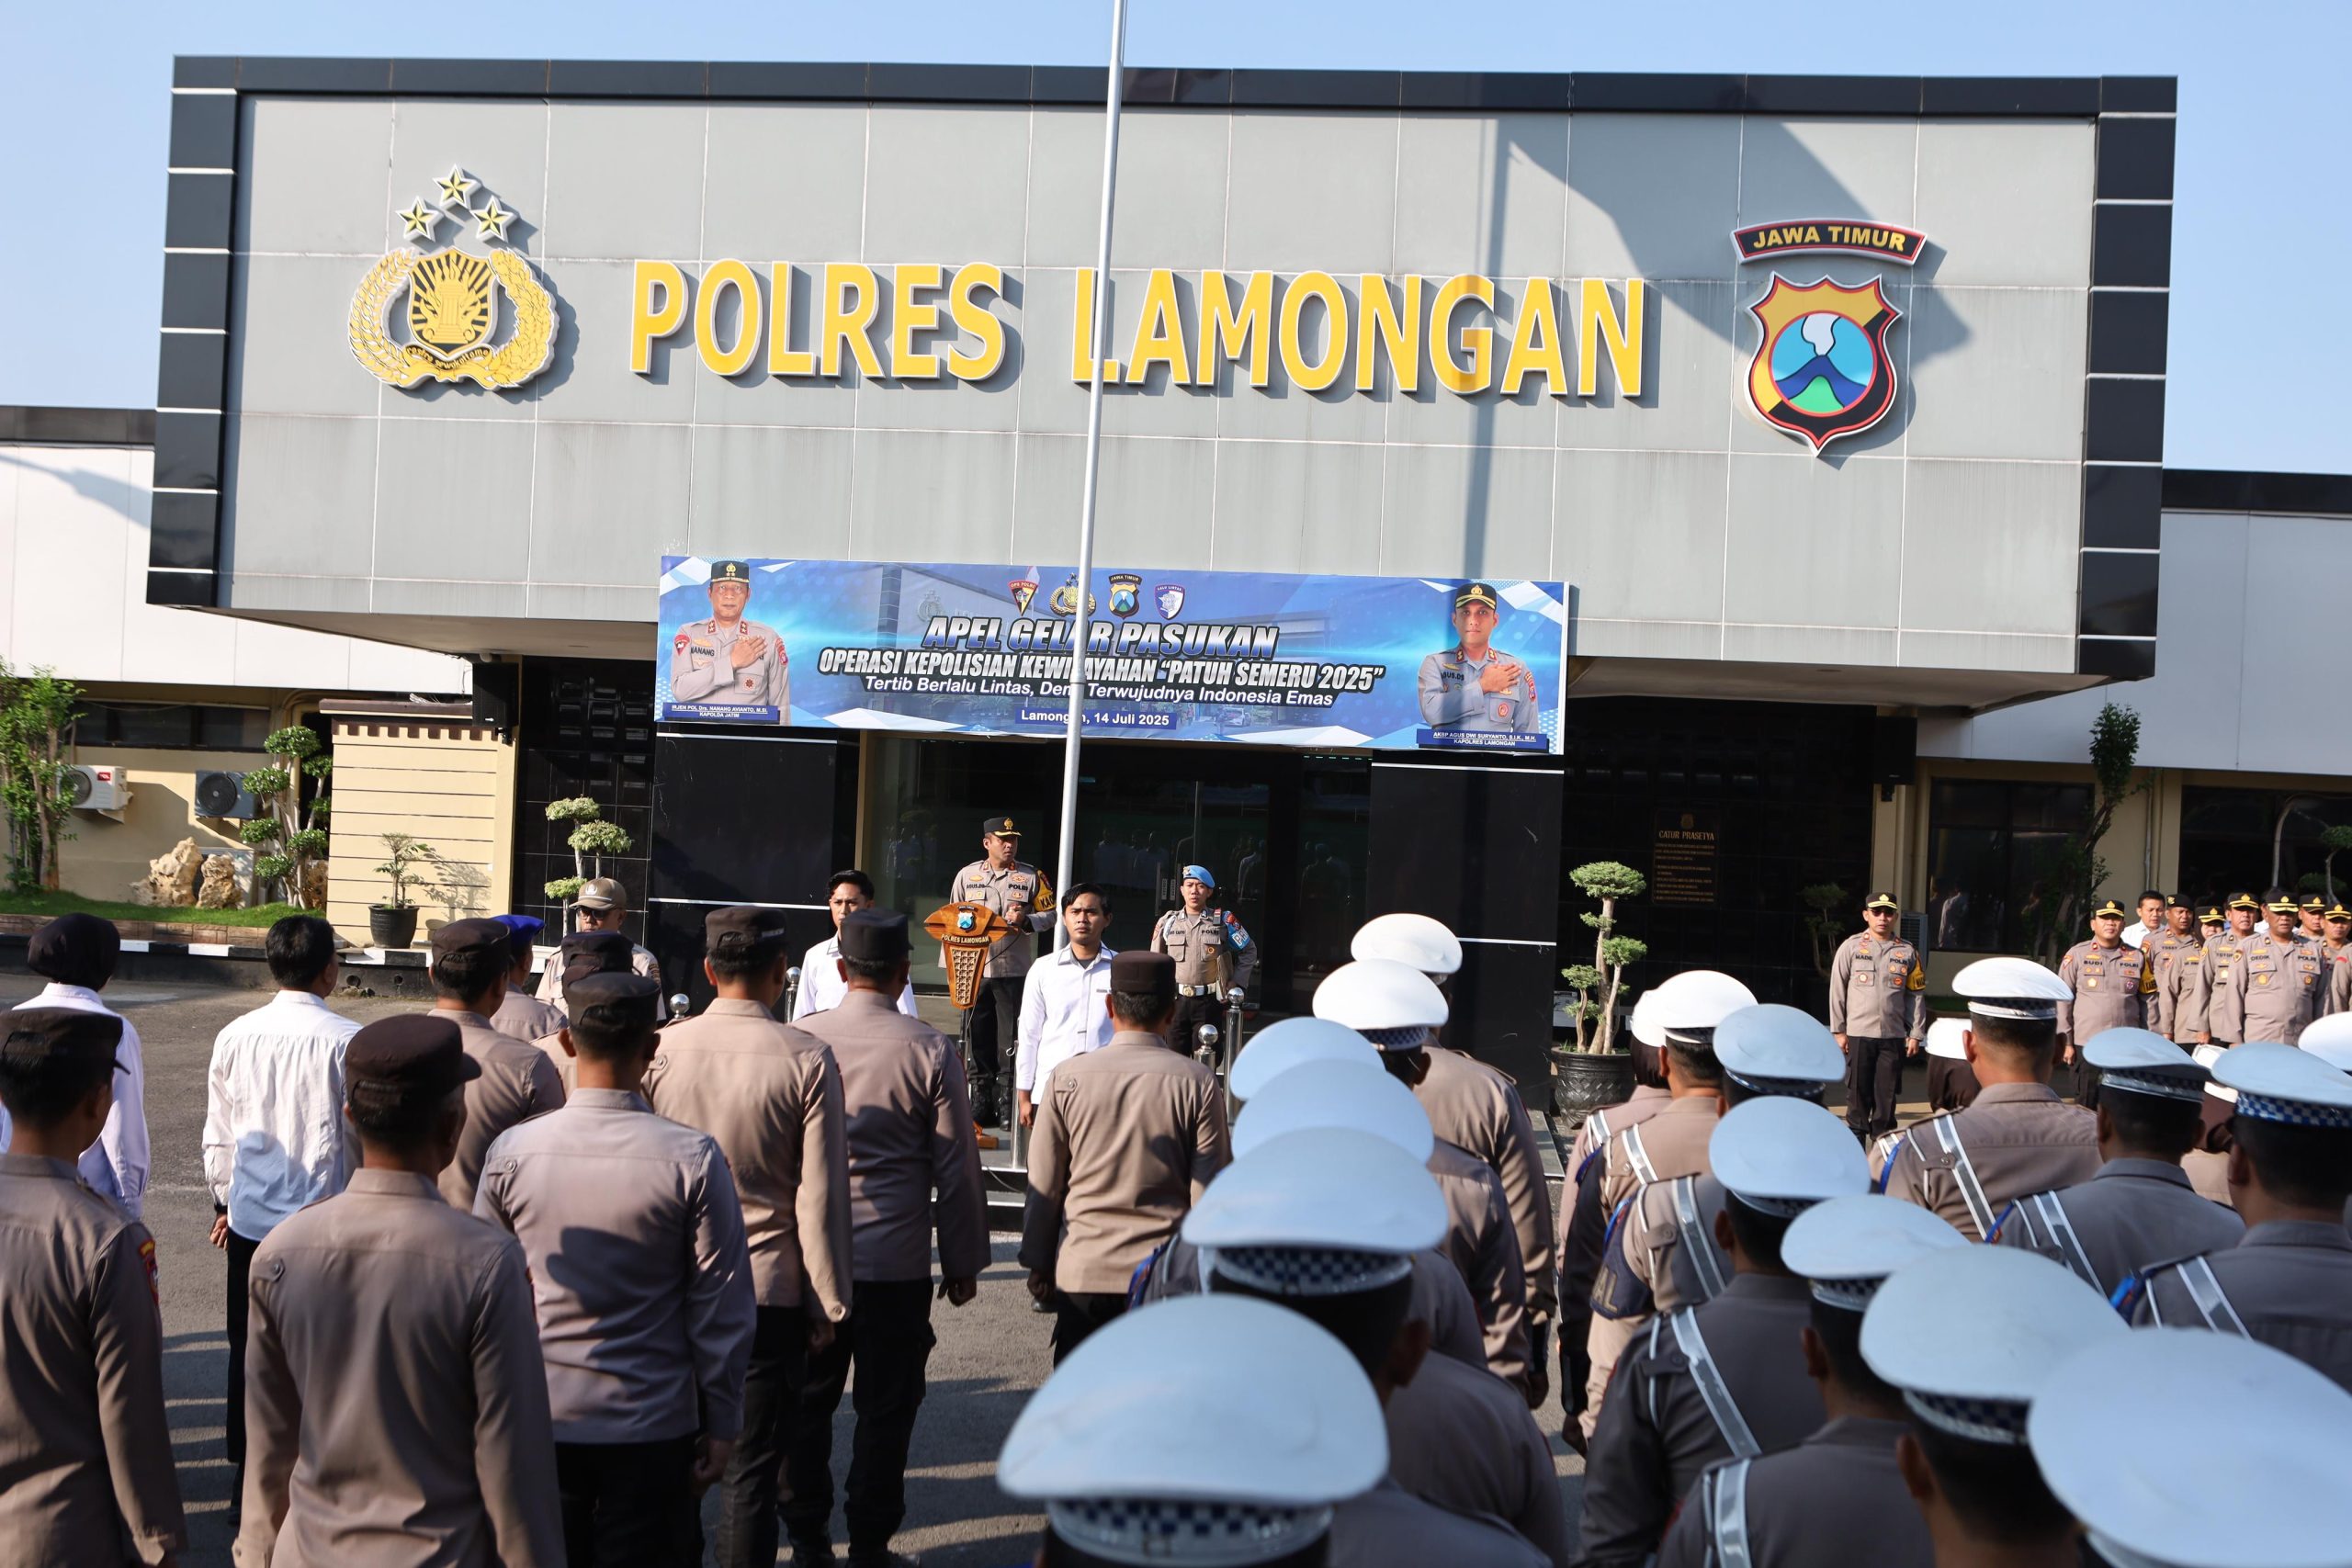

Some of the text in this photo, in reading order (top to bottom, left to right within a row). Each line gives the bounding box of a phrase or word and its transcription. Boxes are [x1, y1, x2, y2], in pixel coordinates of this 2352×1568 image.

[1753, 226, 1906, 252] JAWA TIMUR
[630, 258, 1645, 398] POLRES LAMONGAN
[922, 616, 1001, 649] APEL
[1117, 622, 1279, 659] PASUKAN
[819, 649, 902, 675] OPERASI
[903, 651, 1017, 678] KEPOLISIAN
[1019, 655, 1158, 682] KEWIAYAHAN
[1235, 662, 1317, 689] SEMERU
[865, 675, 1333, 705] Tertib Berlalu Lintas, Dem Terwujudnya Indonesia Emas
[1021, 709, 1170, 726] Lamongn, 14 Juli 2025
[1658, 830, 1714, 840] CATUR PRASETYA
[941, 933, 989, 944] POLRES LAMONGAN
